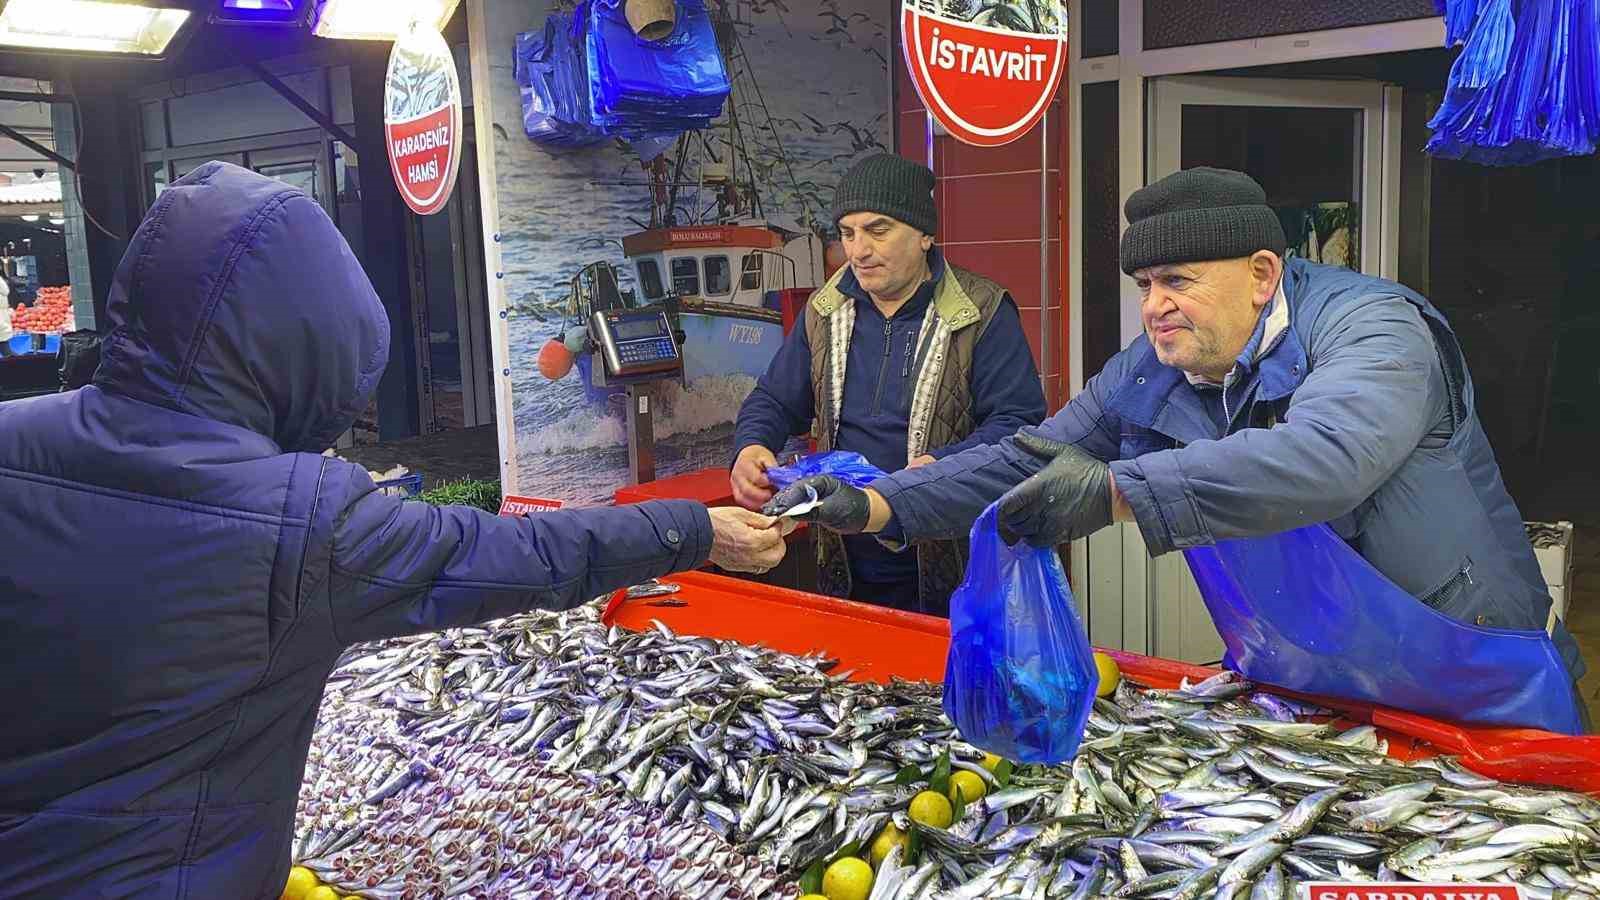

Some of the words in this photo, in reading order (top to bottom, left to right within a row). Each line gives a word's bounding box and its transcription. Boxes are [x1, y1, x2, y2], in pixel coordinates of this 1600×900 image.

[929, 27, 1047, 81] İSTAVRİT
[394, 122, 449, 158] KARADENİZ
[408, 154, 439, 184] HAMSİ
